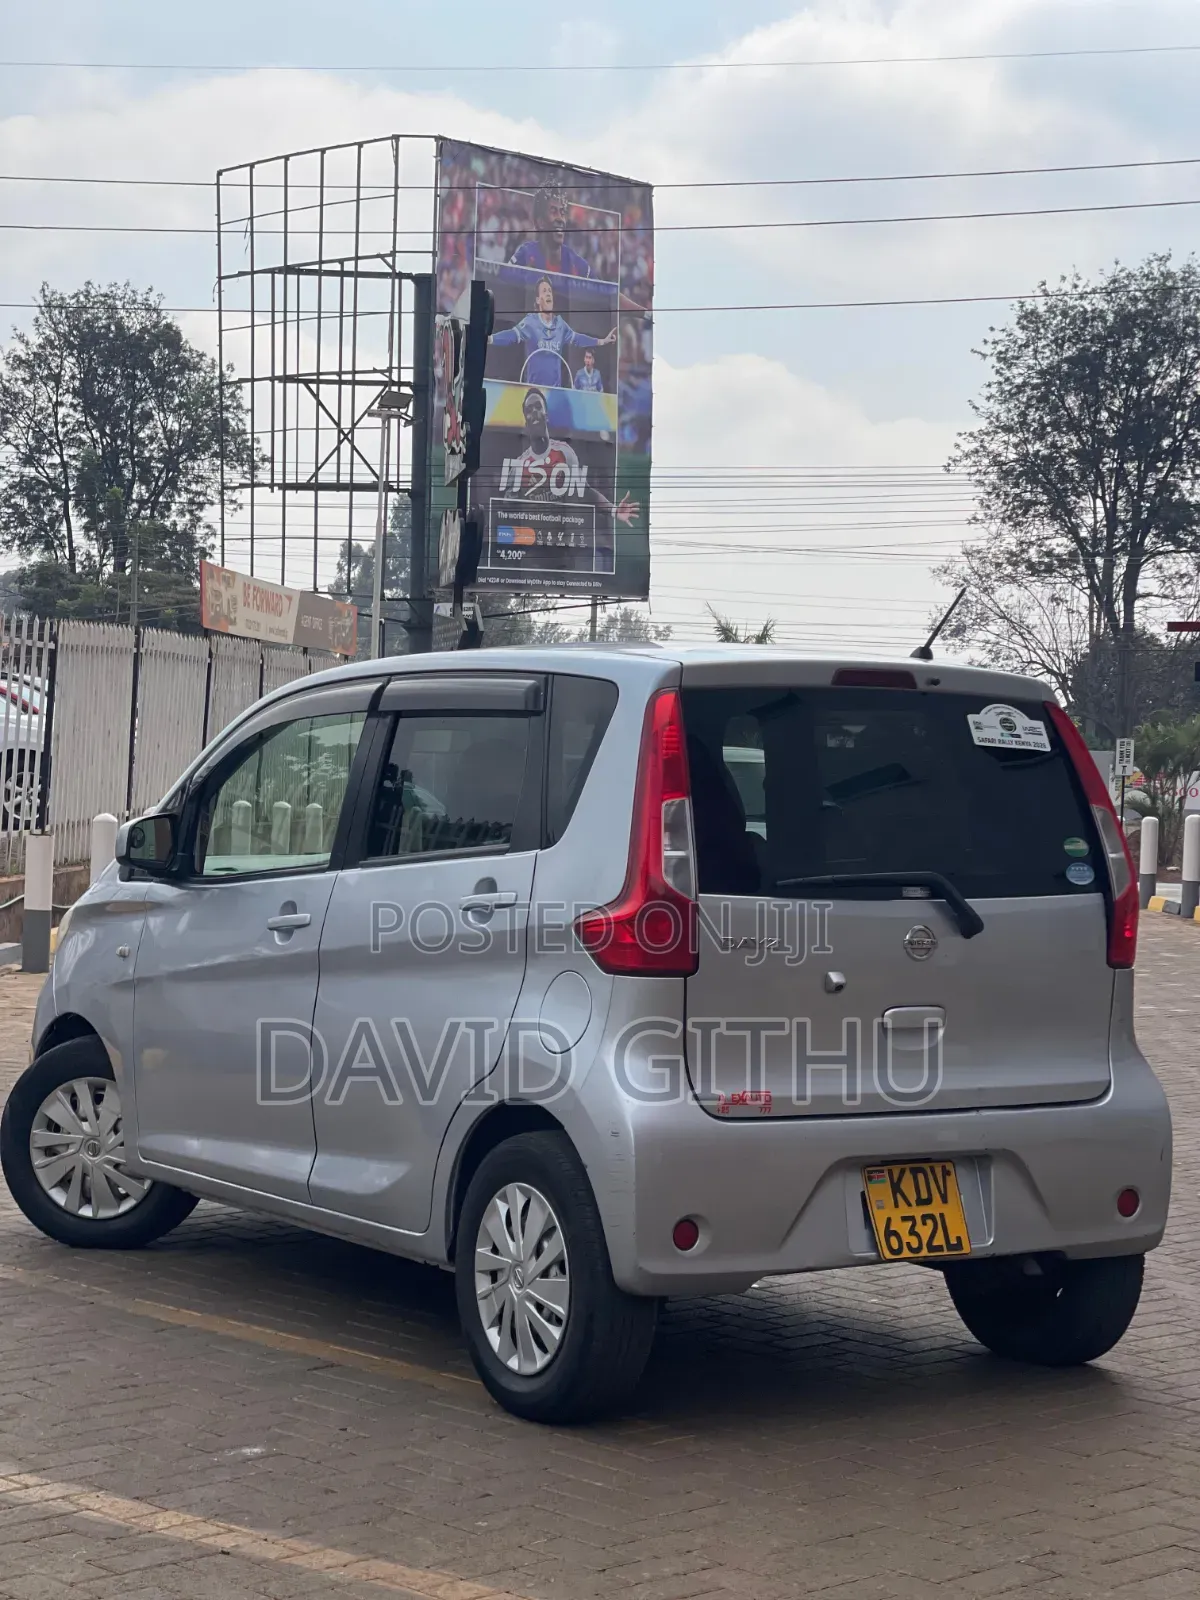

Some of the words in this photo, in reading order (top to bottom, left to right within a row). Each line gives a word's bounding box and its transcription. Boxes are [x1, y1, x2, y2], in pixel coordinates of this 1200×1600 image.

[550, 463, 588, 497] ON
[497, 511, 508, 519] The
[509, 511, 528, 520] world's
[529, 512, 540, 521] best
[541, 513, 561, 522] football
[562, 514, 585, 526] package
[243, 582, 251, 608] BE
[253, 585, 283, 617] FORWARD
[978, 736, 997, 744] SAFARI
[888, 1165, 948, 1208] KDV
[884, 1213, 964, 1256] 632L
